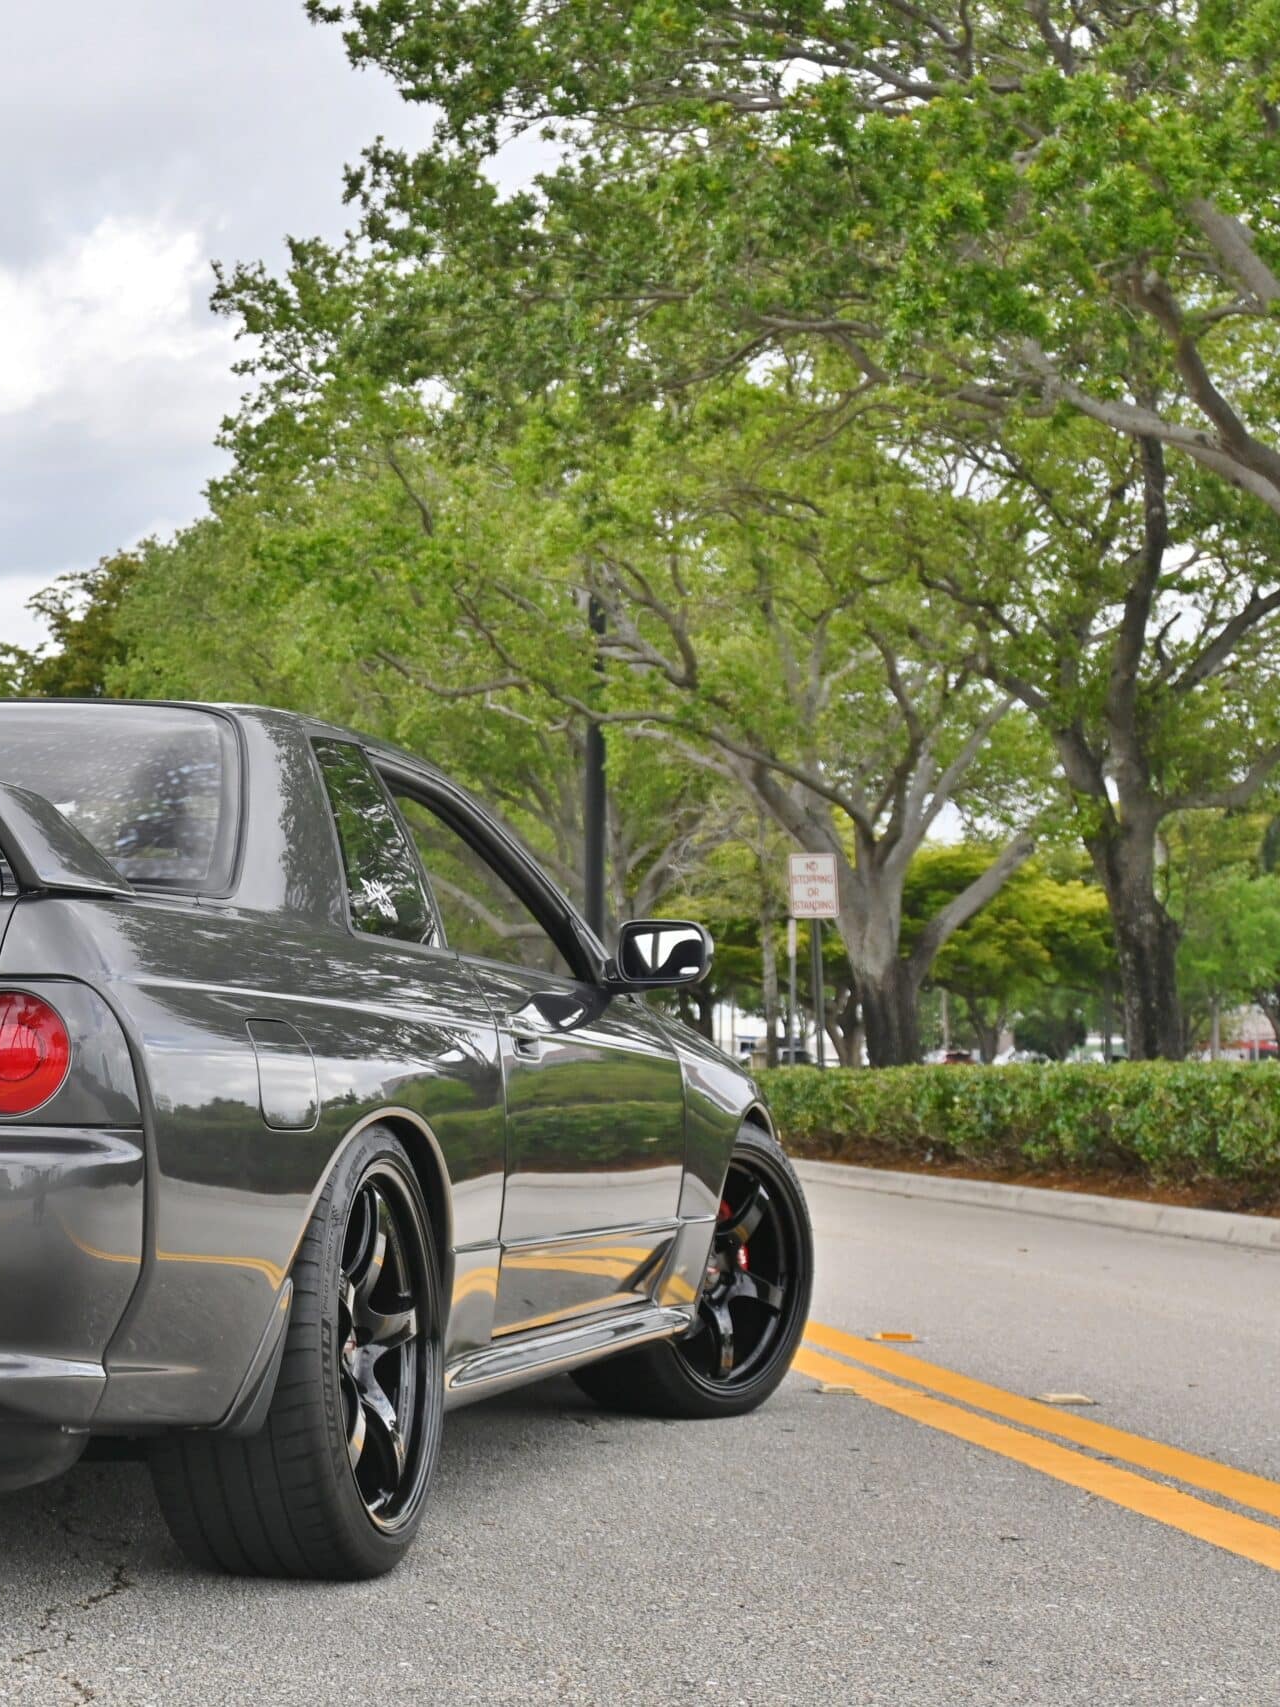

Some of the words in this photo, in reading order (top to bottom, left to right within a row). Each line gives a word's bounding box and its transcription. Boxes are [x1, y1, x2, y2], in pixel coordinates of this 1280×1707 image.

[806, 861, 817, 872] NO
[792, 874, 833, 885] STOPPING
[808, 887, 819, 897] OR
[793, 900, 834, 911] STANDING
[322, 1327, 339, 1448] MICHELIN
